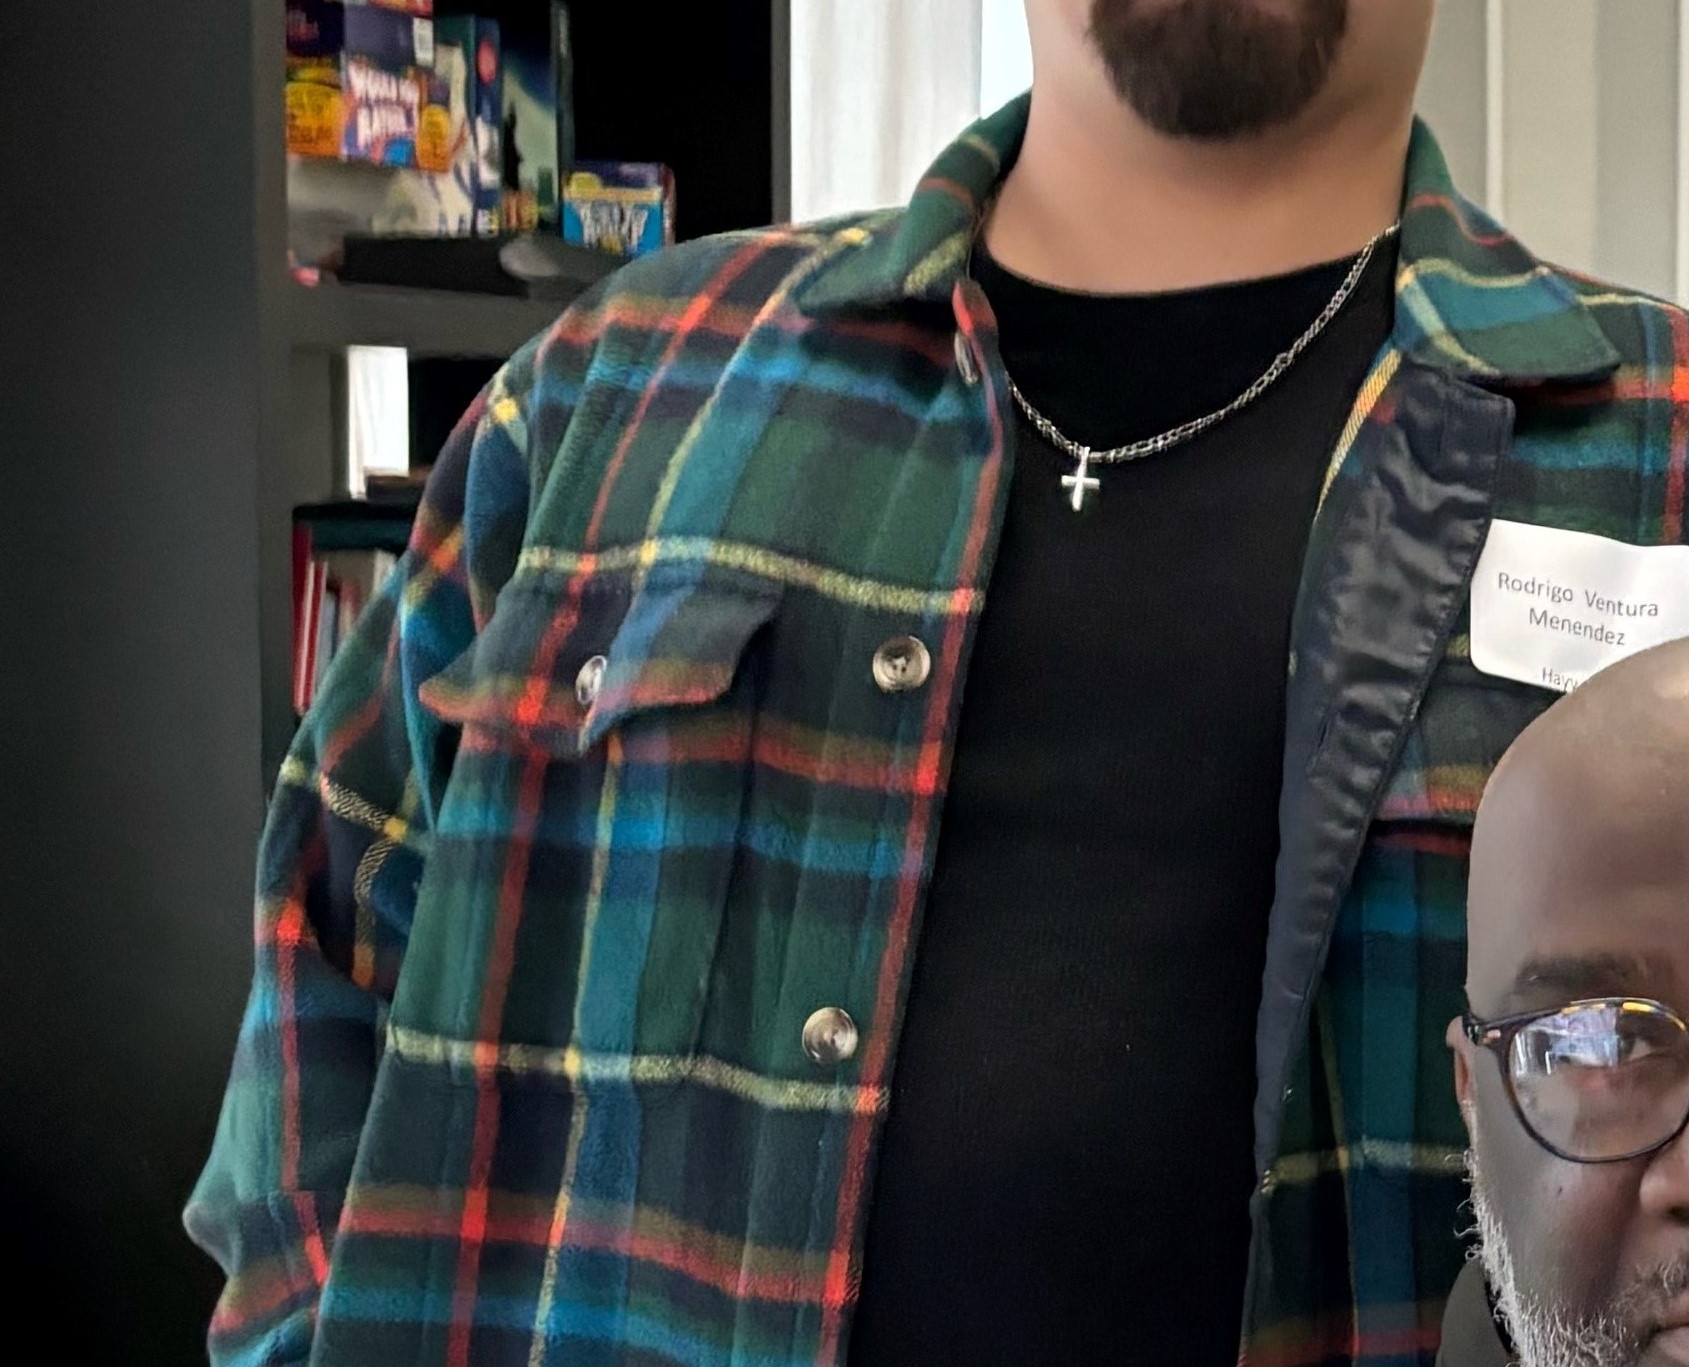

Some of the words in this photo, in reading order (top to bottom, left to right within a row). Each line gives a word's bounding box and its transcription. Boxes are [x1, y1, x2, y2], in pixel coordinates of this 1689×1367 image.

[1498, 571, 1574, 603] Rodrigo
[1584, 589, 1659, 617] Ventura
[1529, 607, 1626, 646] Menendez
